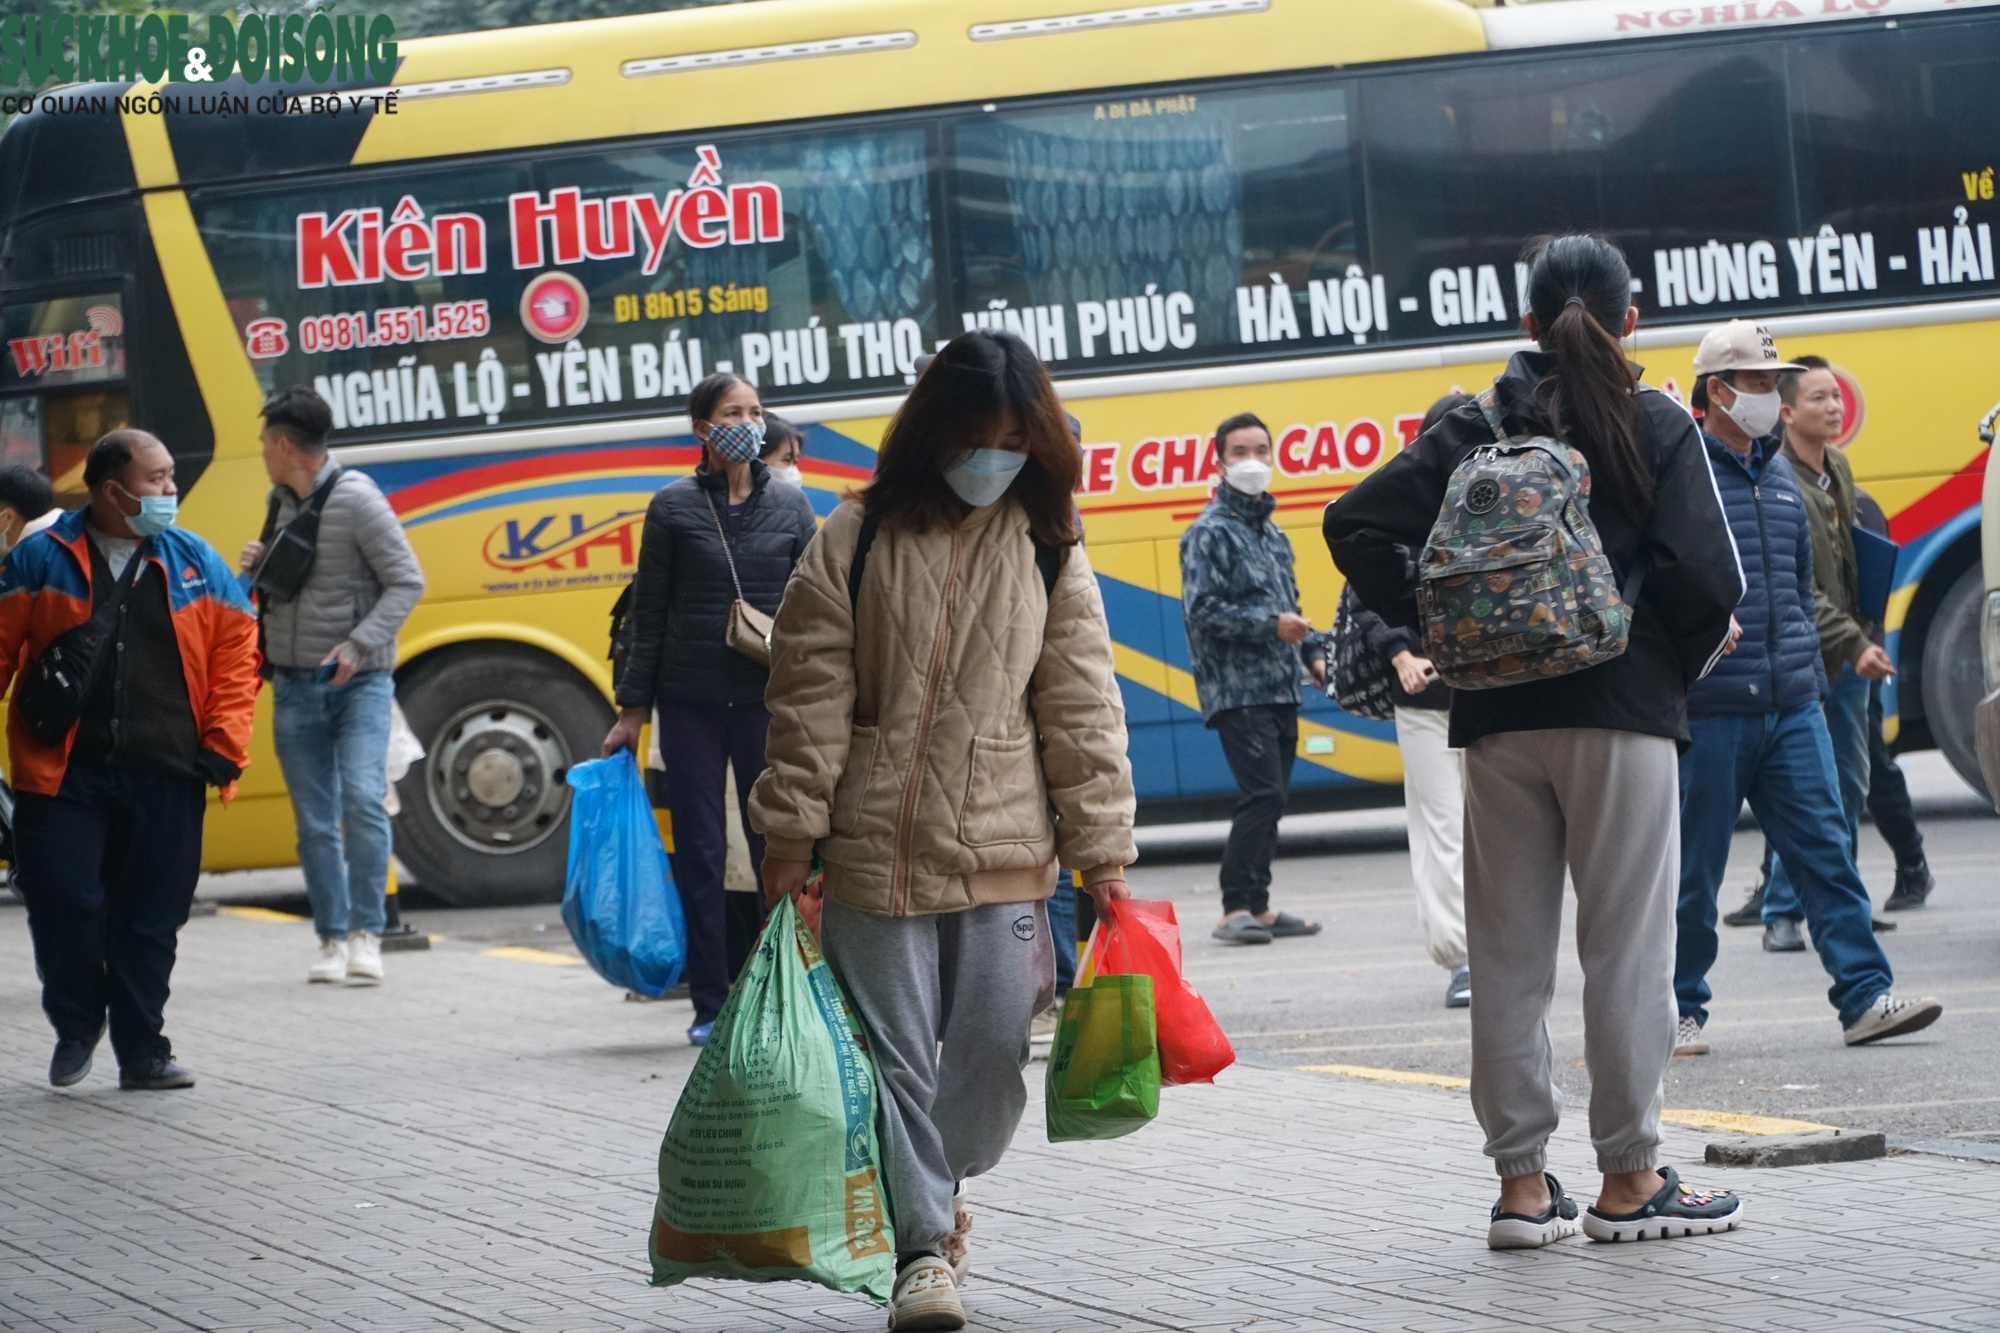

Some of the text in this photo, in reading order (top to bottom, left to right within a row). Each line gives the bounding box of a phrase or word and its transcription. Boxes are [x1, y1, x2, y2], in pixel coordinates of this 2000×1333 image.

[1094, 104, 1106, 121] A
[296, 144, 785, 289] Kiên Huyền
[314, 355, 446, 430] NGHĨA
[453, 347, 506, 425] LỘ
[535, 338, 623, 408] YÊN
[630, 329, 704, 399] BÁI
[741, 315, 831, 388] PHÚ
[838, 317, 922, 386] THỌ
[1076, 283, 1198, 358] PHÚC
[1236, 272, 1300, 344] HÀ
[1308, 264, 1389, 345] NỘI
[1428, 264, 1507, 327] GIA
[1654, 238, 1780, 308] HƯNG
[1787, 223, 1878, 295] YÊN
[1917, 204, 1995, 285] HẢI
[613, 283, 768, 322] Đi 8h15 Sáng
[299, 299, 490, 353] 0981.551.525
[7, 330, 104, 378] Wifi
[1073, 442, 1120, 498] E
[1272, 417, 1386, 478] CAO
[747, 1070, 763, 1080] 0,71
[846, 1068, 855, 1078] 22
[853, 1185, 875, 1213] VN
